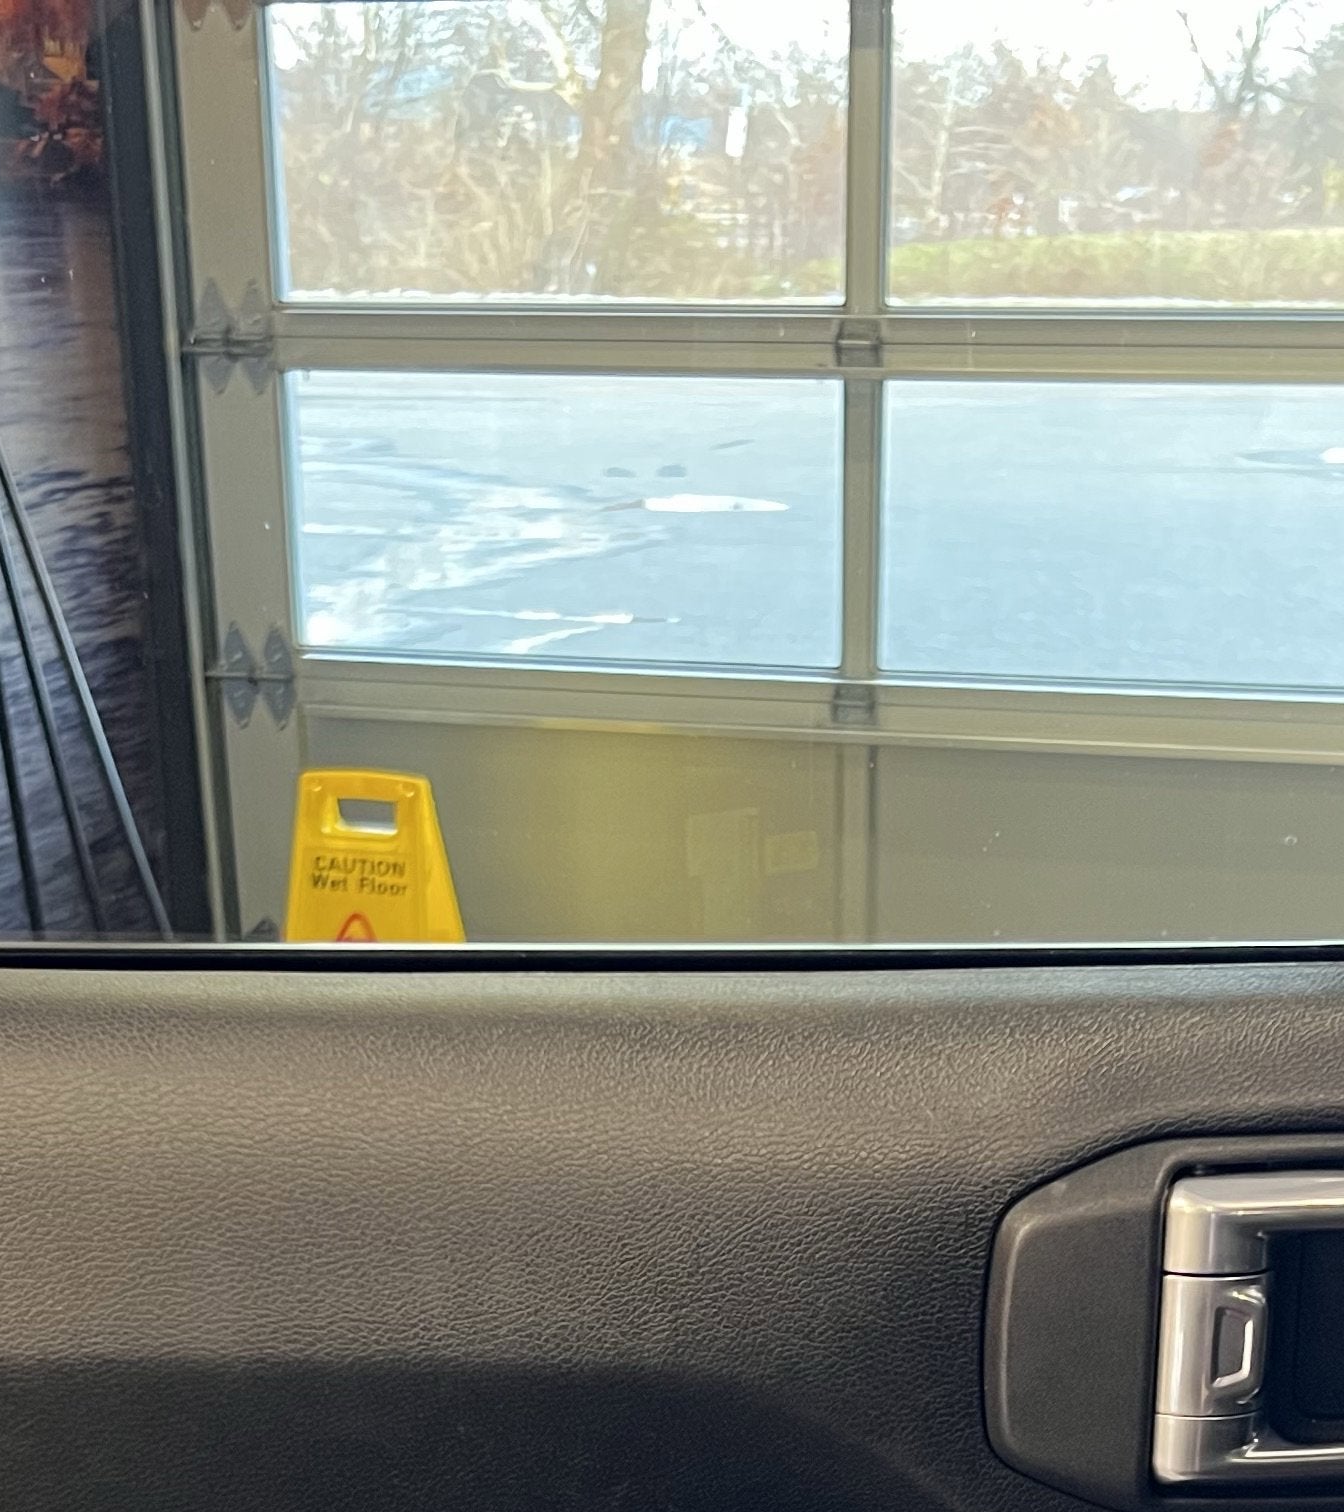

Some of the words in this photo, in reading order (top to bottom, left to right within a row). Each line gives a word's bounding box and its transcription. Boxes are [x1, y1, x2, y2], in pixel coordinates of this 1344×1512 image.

[313, 855, 407, 879] CAUTION
[311, 872, 349, 892] Wet
[358, 876, 408, 897] Floor
